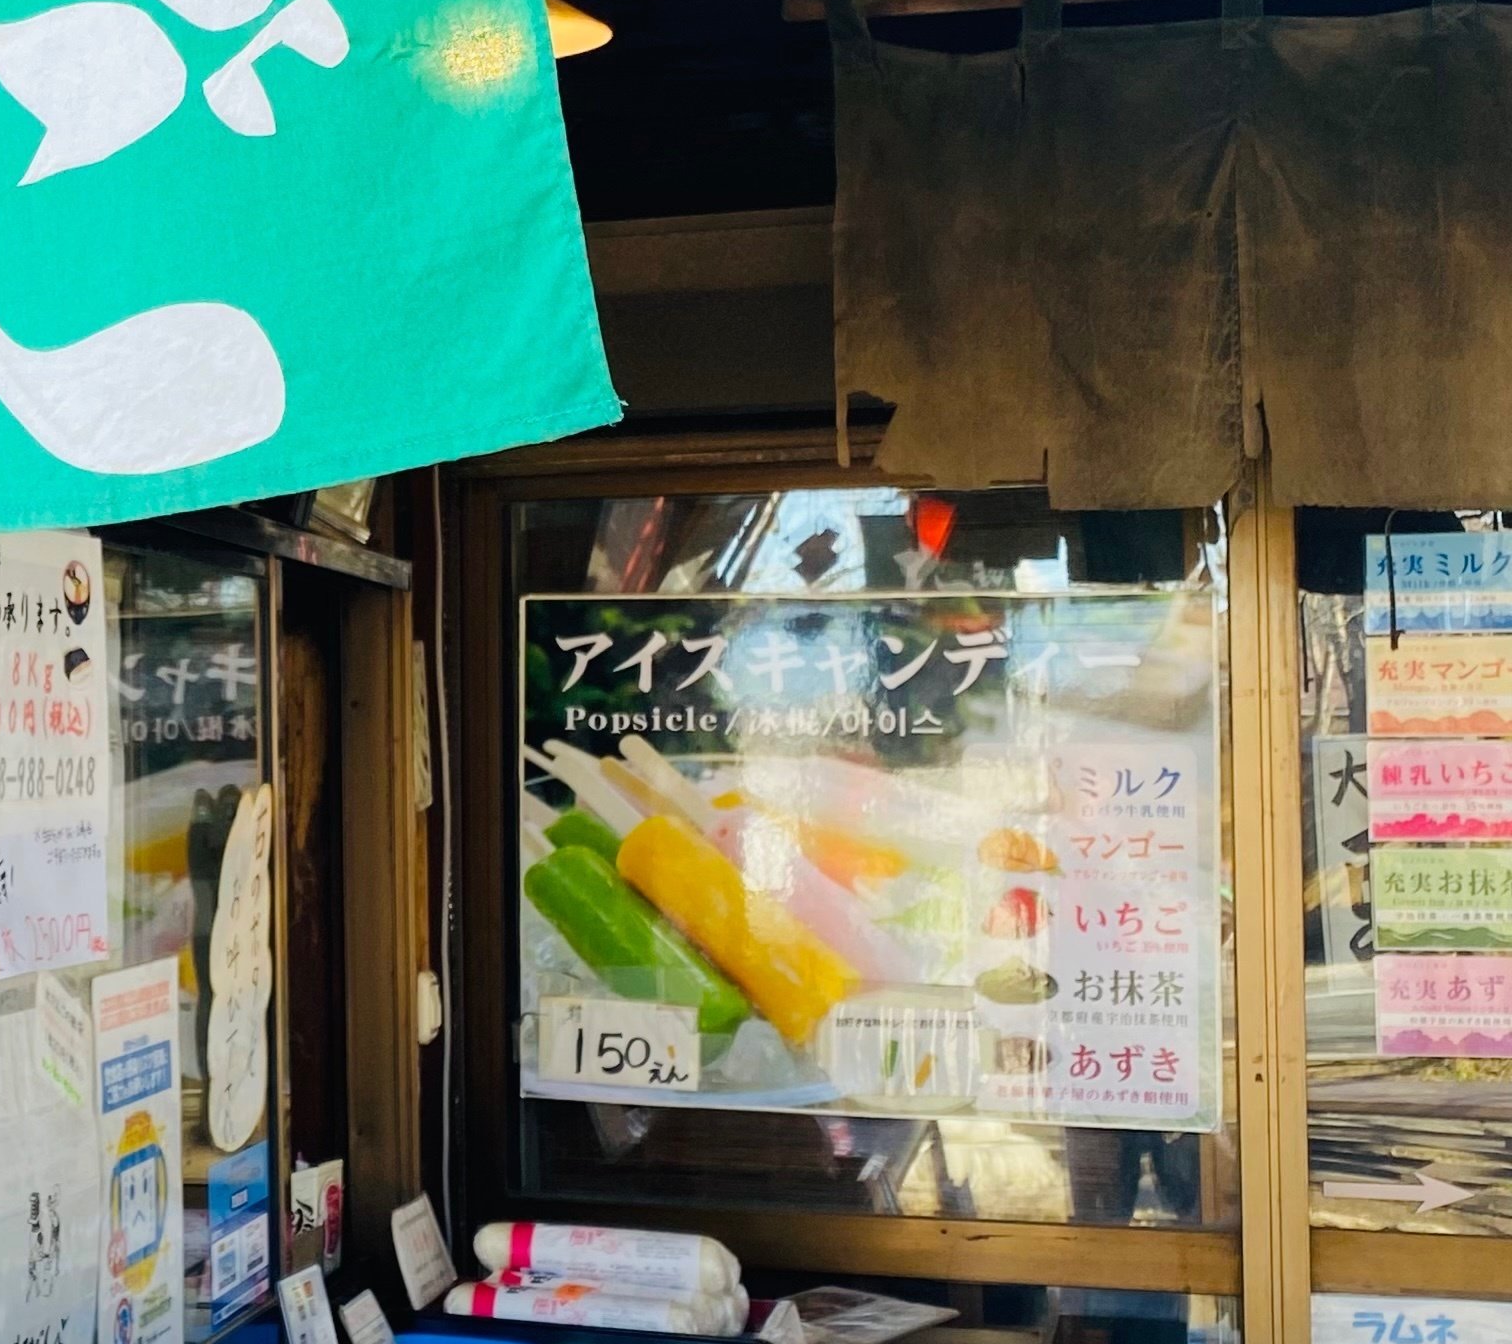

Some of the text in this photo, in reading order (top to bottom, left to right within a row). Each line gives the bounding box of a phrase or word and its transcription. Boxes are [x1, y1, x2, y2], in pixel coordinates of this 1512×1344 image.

[555, 630, 1142, 696] アイスキャンディー
[1378, 659, 1512, 682] 充実マンゴ
[1080, 766, 1181, 799] ミルク
[1069, 830, 1185, 860] マンゴー
[1075, 902, 1187, 938] いちご
[1072, 969, 1185, 1007] お抹茶
[1069, 1043, 1180, 1083] あずき
